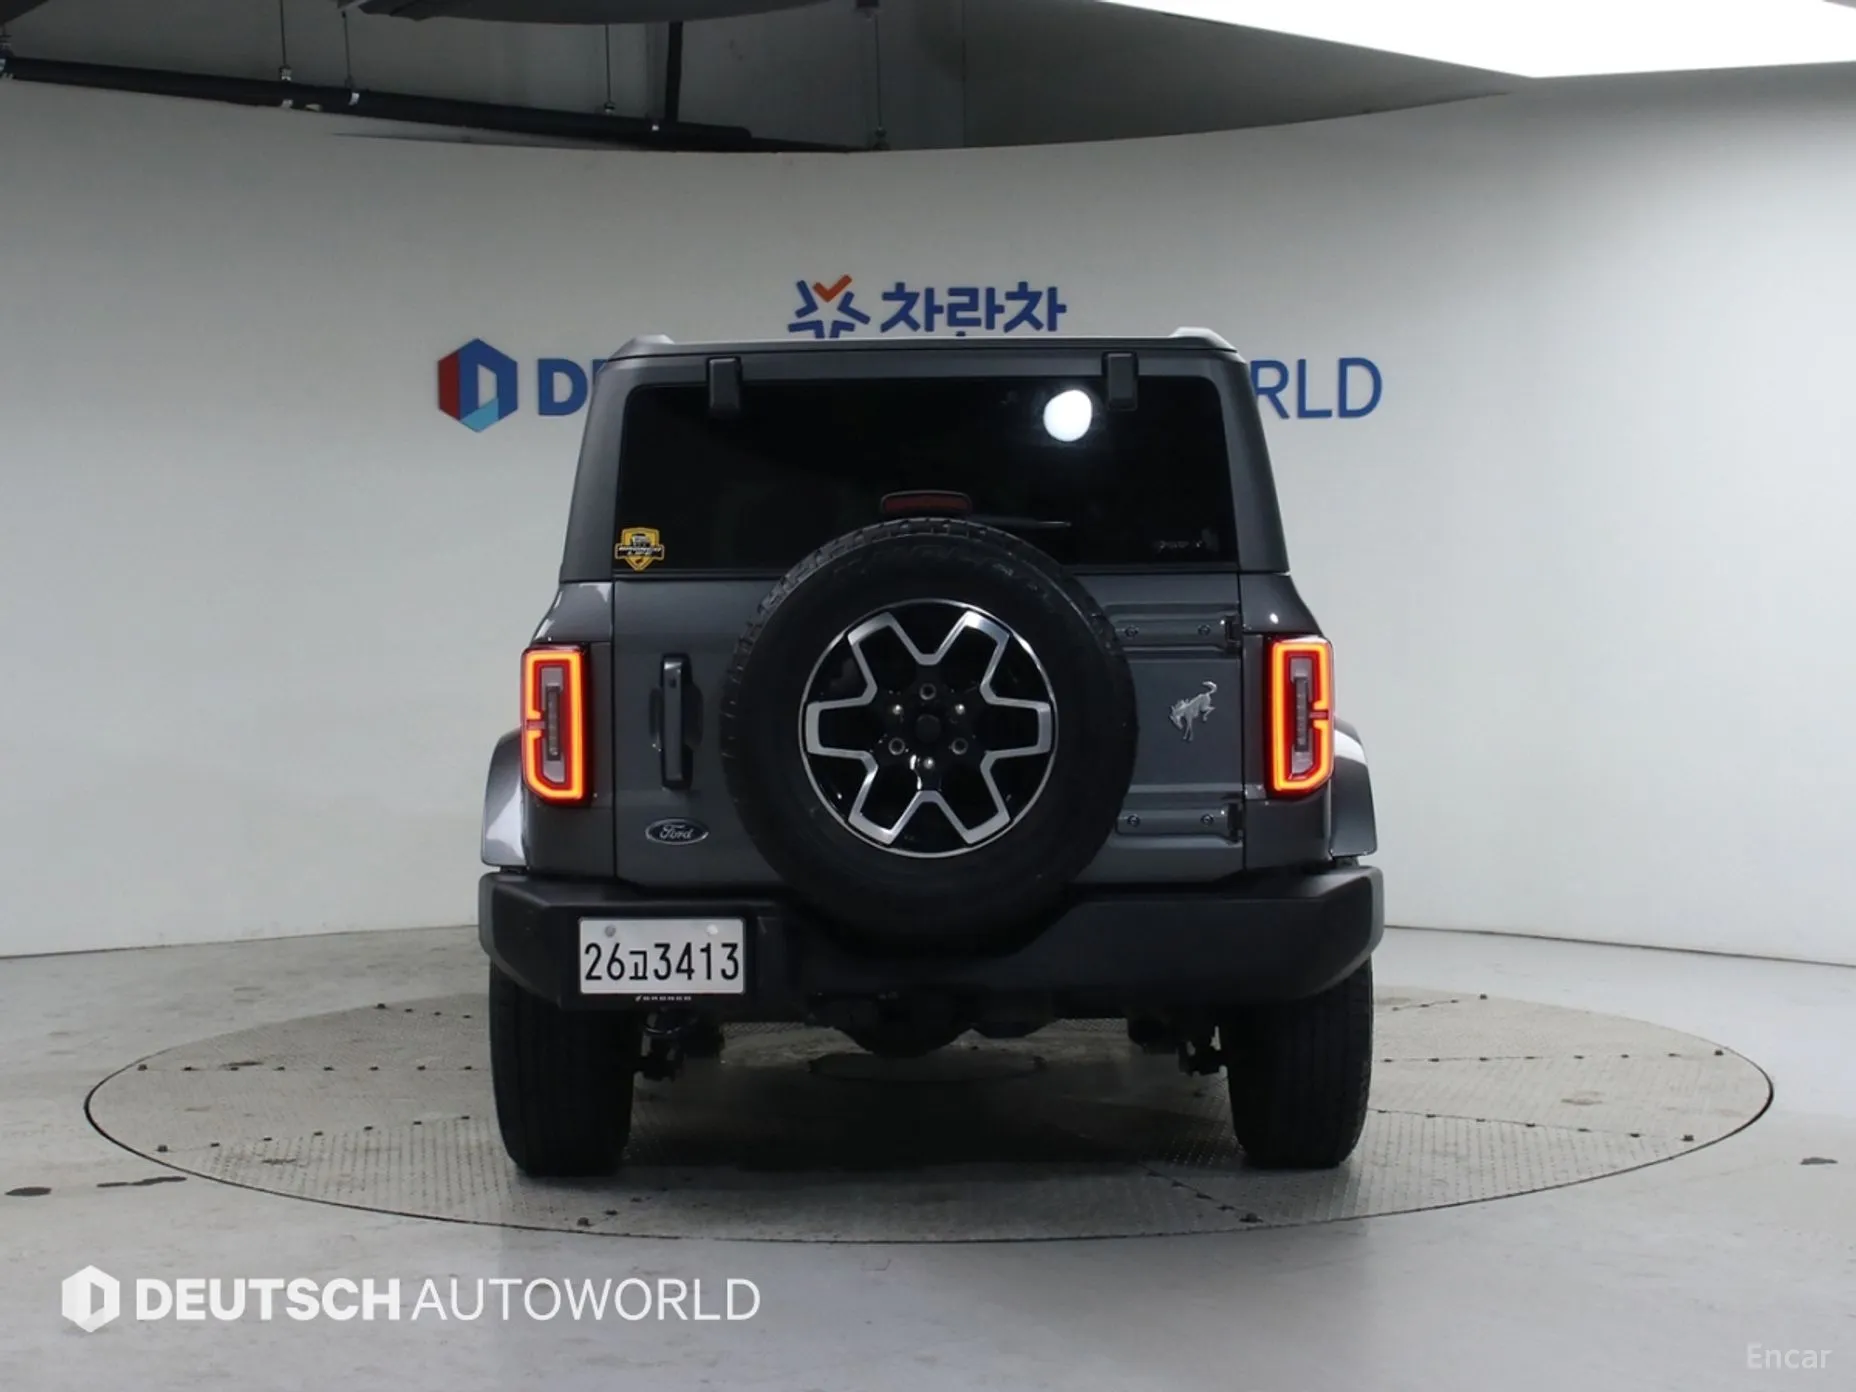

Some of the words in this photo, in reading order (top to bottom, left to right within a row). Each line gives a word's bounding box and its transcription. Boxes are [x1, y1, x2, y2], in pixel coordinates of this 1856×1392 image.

[538, 358, 607, 416] D
[660, 824, 694, 839] Ford
[584, 942, 740, 981] 26고3413
